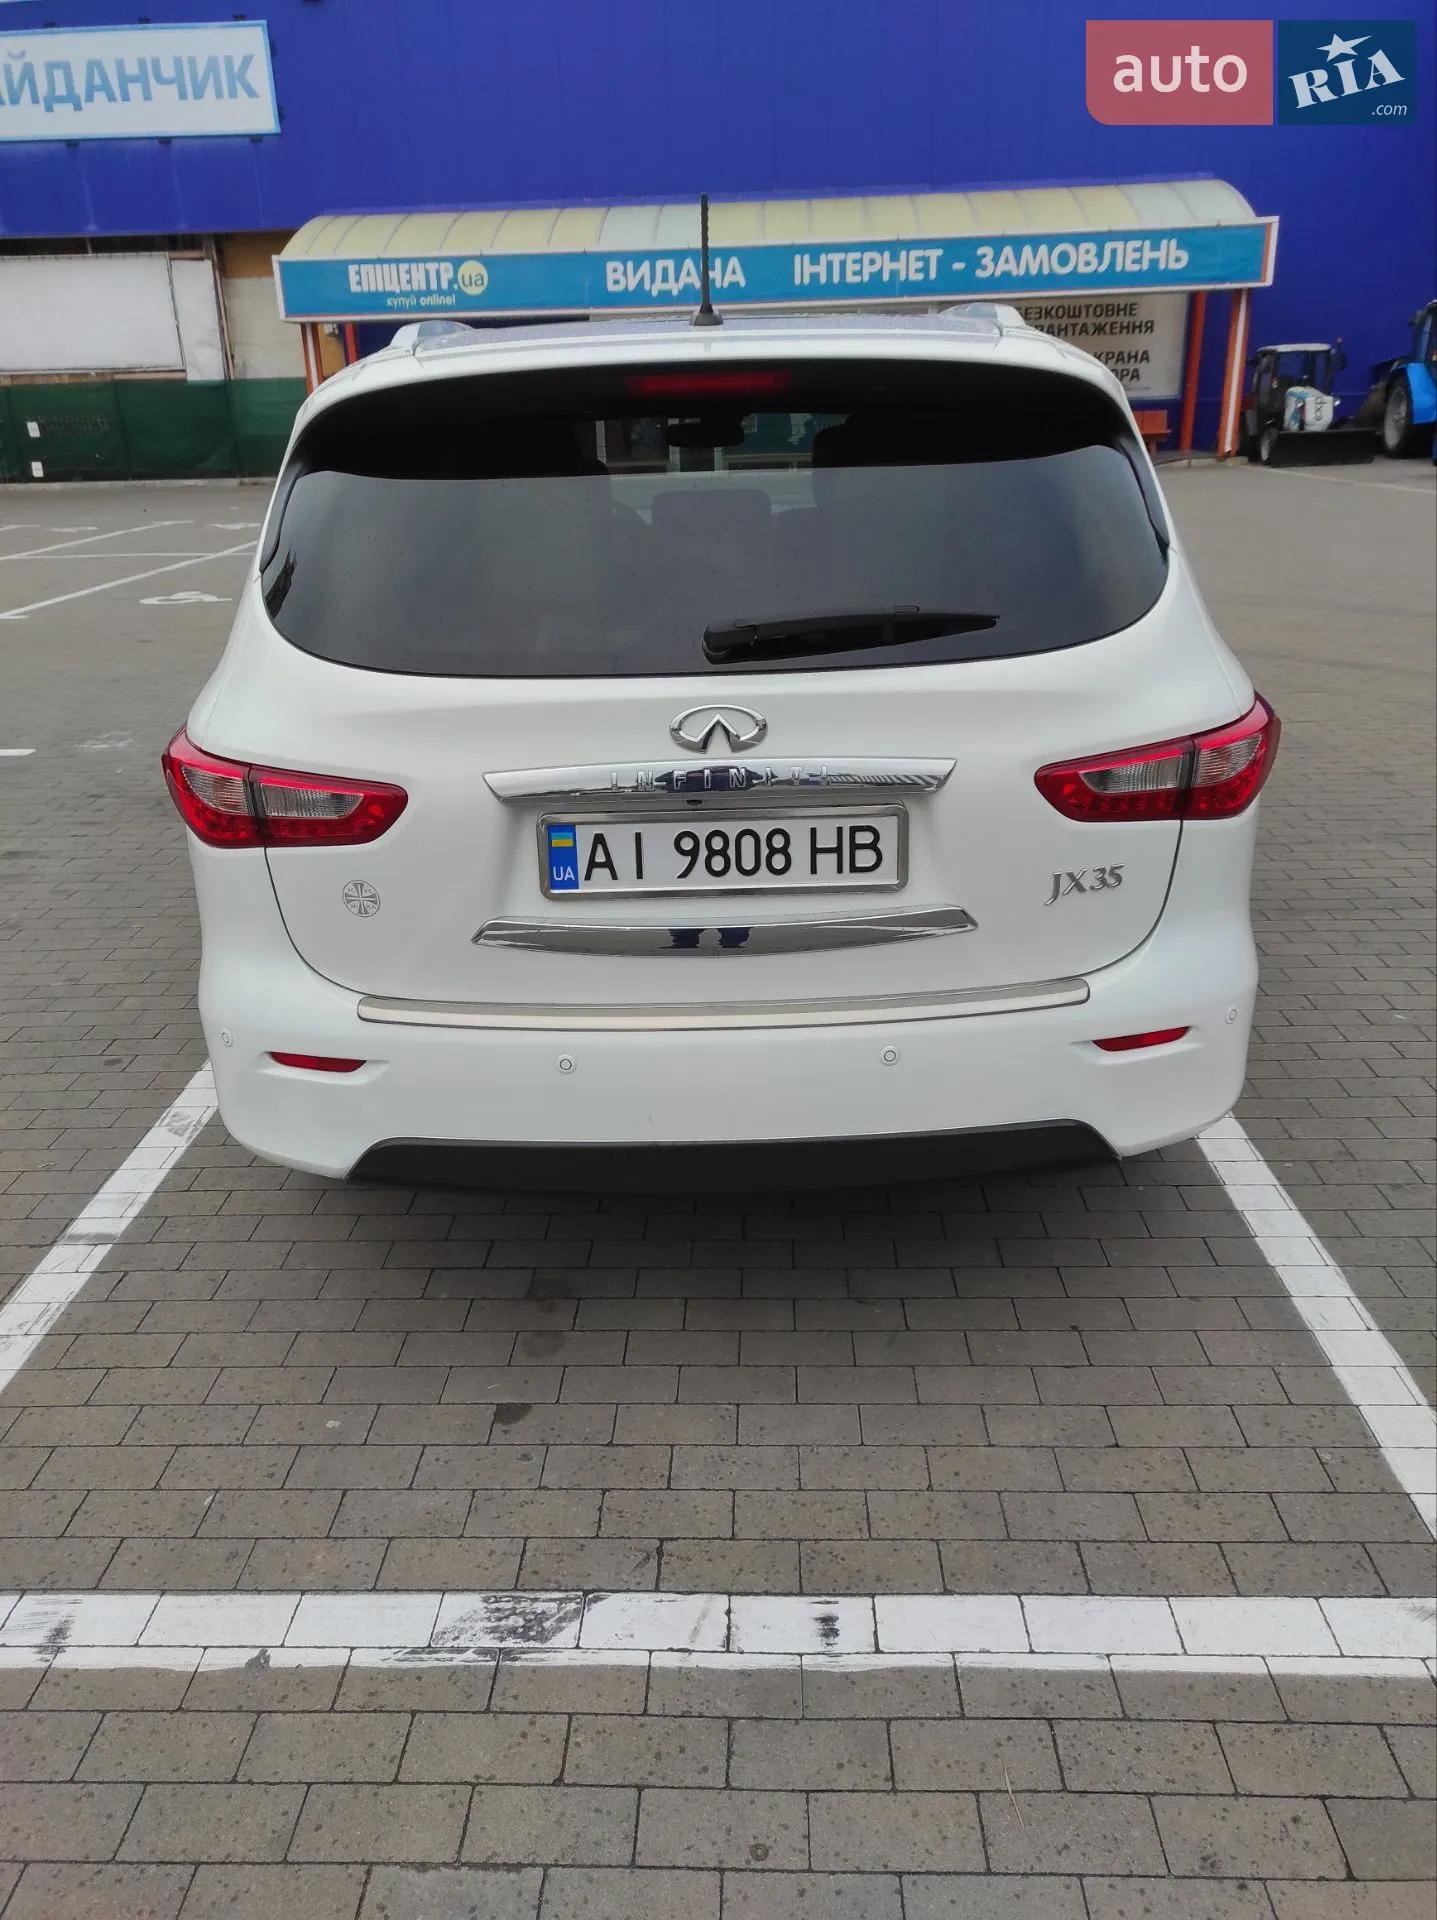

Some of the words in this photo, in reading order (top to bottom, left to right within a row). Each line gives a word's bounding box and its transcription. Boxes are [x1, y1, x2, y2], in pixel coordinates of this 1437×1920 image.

[0, 49, 260, 113] ЙДАНЧИК
[794, 248, 944, 285] ІНТЕРНЕТ
[975, 238, 1189, 279] ЗАМОВЛЕНЬ
[387, 294, 417, 310] купуй
[610, 765, 830, 792] INFINITI
[552, 866, 576, 882] UA
[584, 832, 644, 882] AI
[673, 827, 792, 880] 9808
[809, 824, 884, 875] HB
[1044, 863, 1125, 906] JX35
